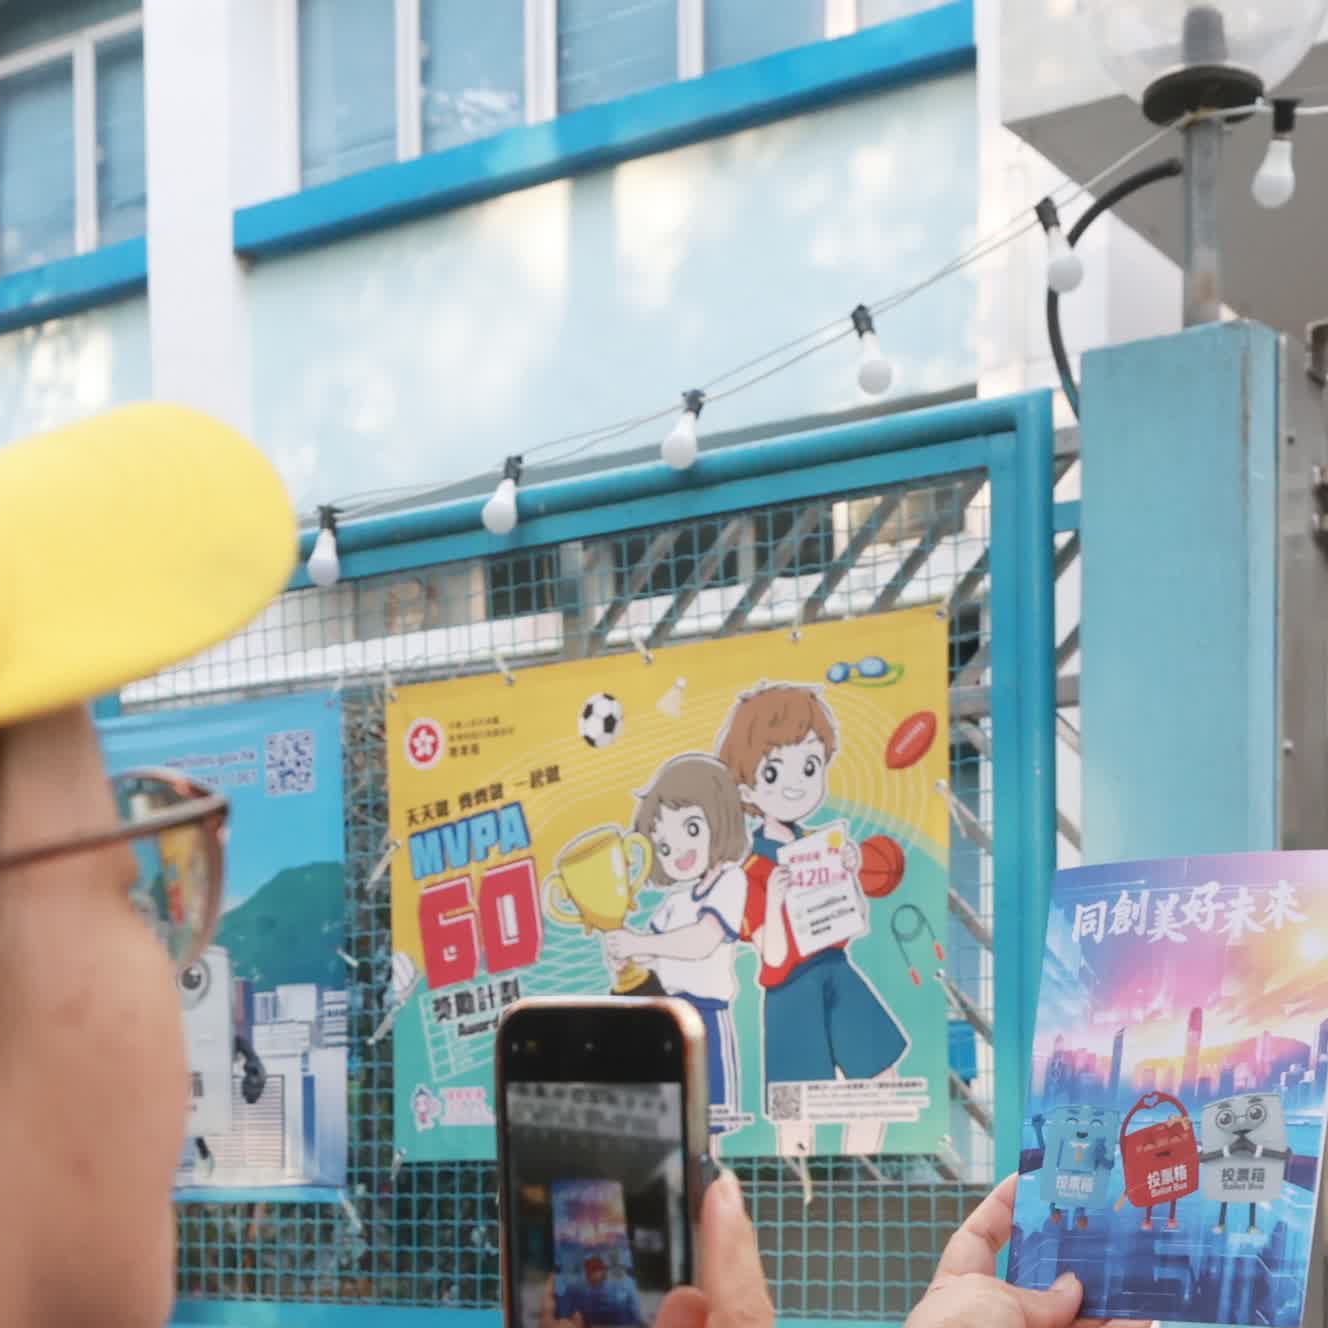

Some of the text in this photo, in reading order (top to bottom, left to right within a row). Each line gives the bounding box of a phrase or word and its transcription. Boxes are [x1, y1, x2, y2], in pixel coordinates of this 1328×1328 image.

[408, 802, 531, 880] MVPA
[418, 856, 543, 991] 60
[1071, 880, 1310, 944] 同創美好未來
[1147, 1164, 1188, 1189] 投票箱
[1221, 1168, 1265, 1183] 投票箱
